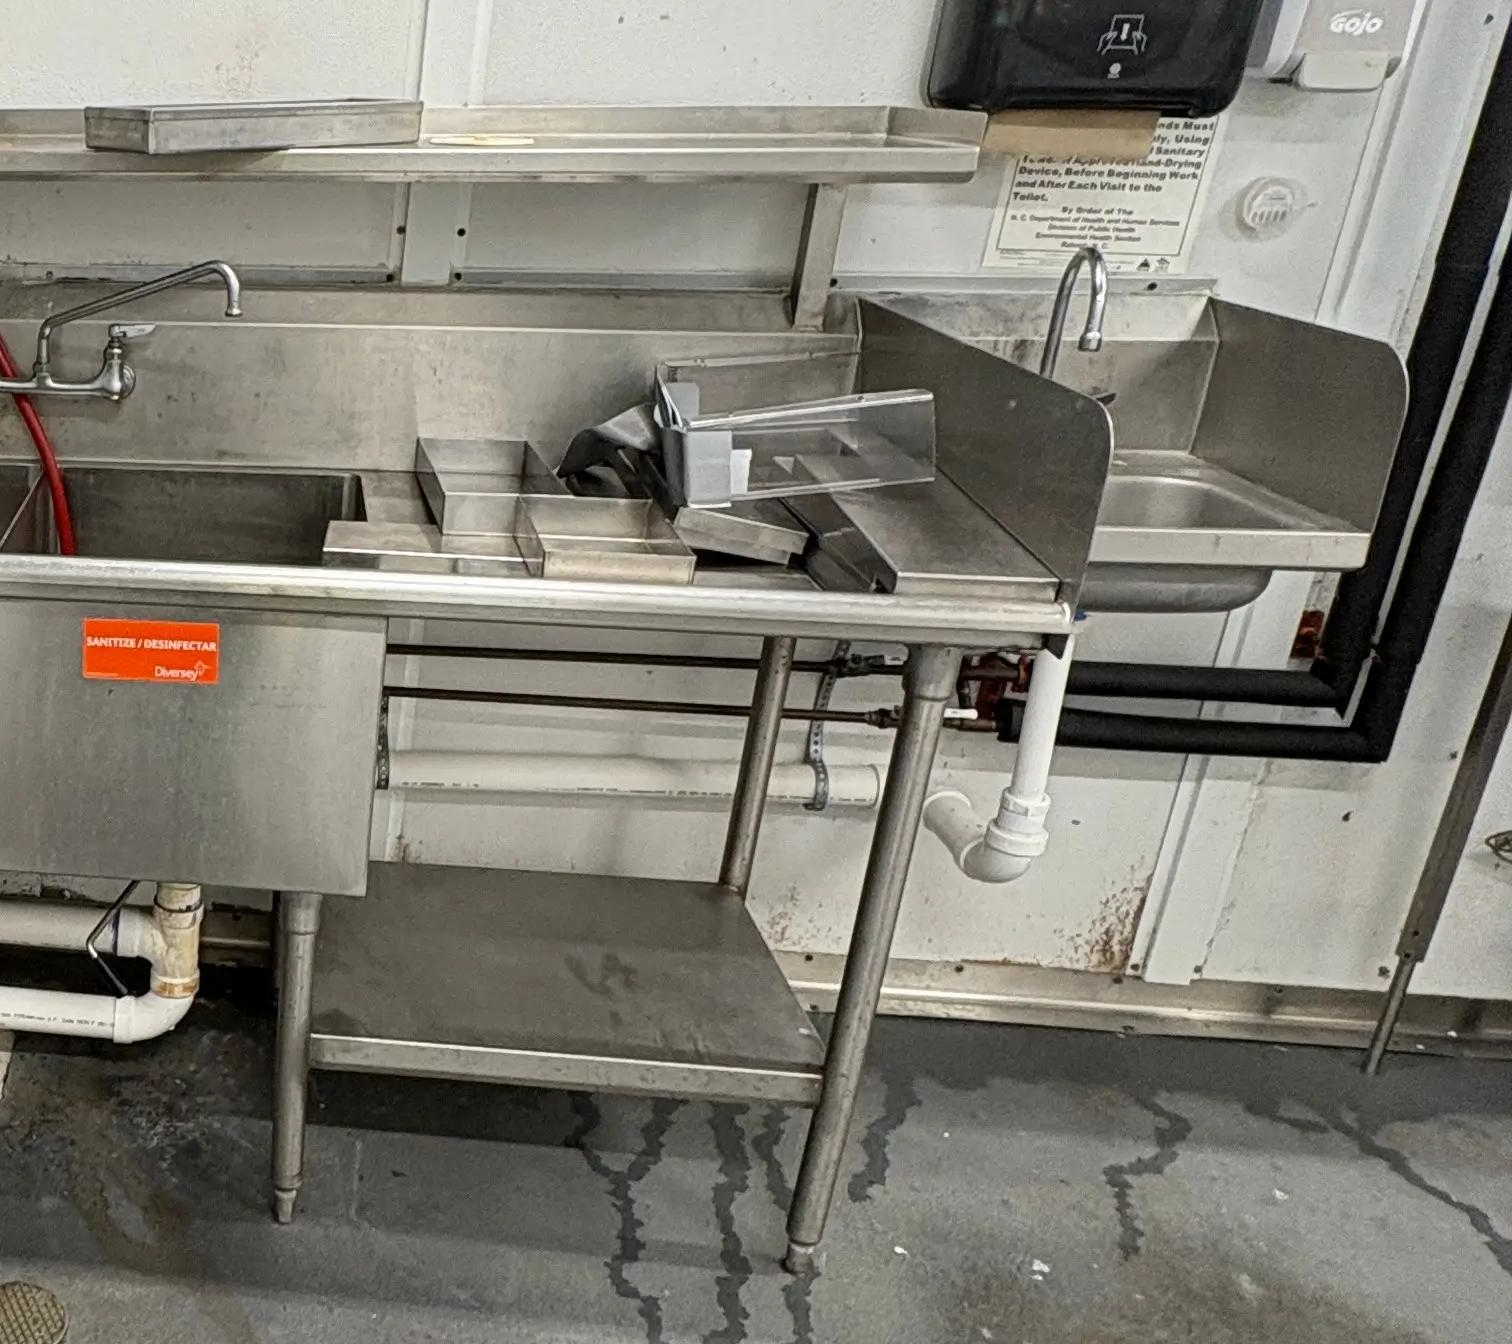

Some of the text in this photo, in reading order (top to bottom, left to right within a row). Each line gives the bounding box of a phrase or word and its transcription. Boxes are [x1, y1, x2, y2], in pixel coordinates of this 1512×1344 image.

[1330, 9, 1384, 36] GOJO
[1158, 121, 1214, 131] nds Must
[1174, 134, 1210, 146] Using
[1155, 147, 1206, 158] Sanitary
[1019, 166, 1199, 180] Device, Before Beginning Work
[1015, 180, 1163, 192] and After Each Visit to the
[1013, 192, 1049, 202] Toilet.
[1061, 206, 1073, 215] By
[86, 636, 136, 649] SANITIZE
[144, 639, 217, 652] DESINFECTAR
[155, 665, 199, 682] Diversey
